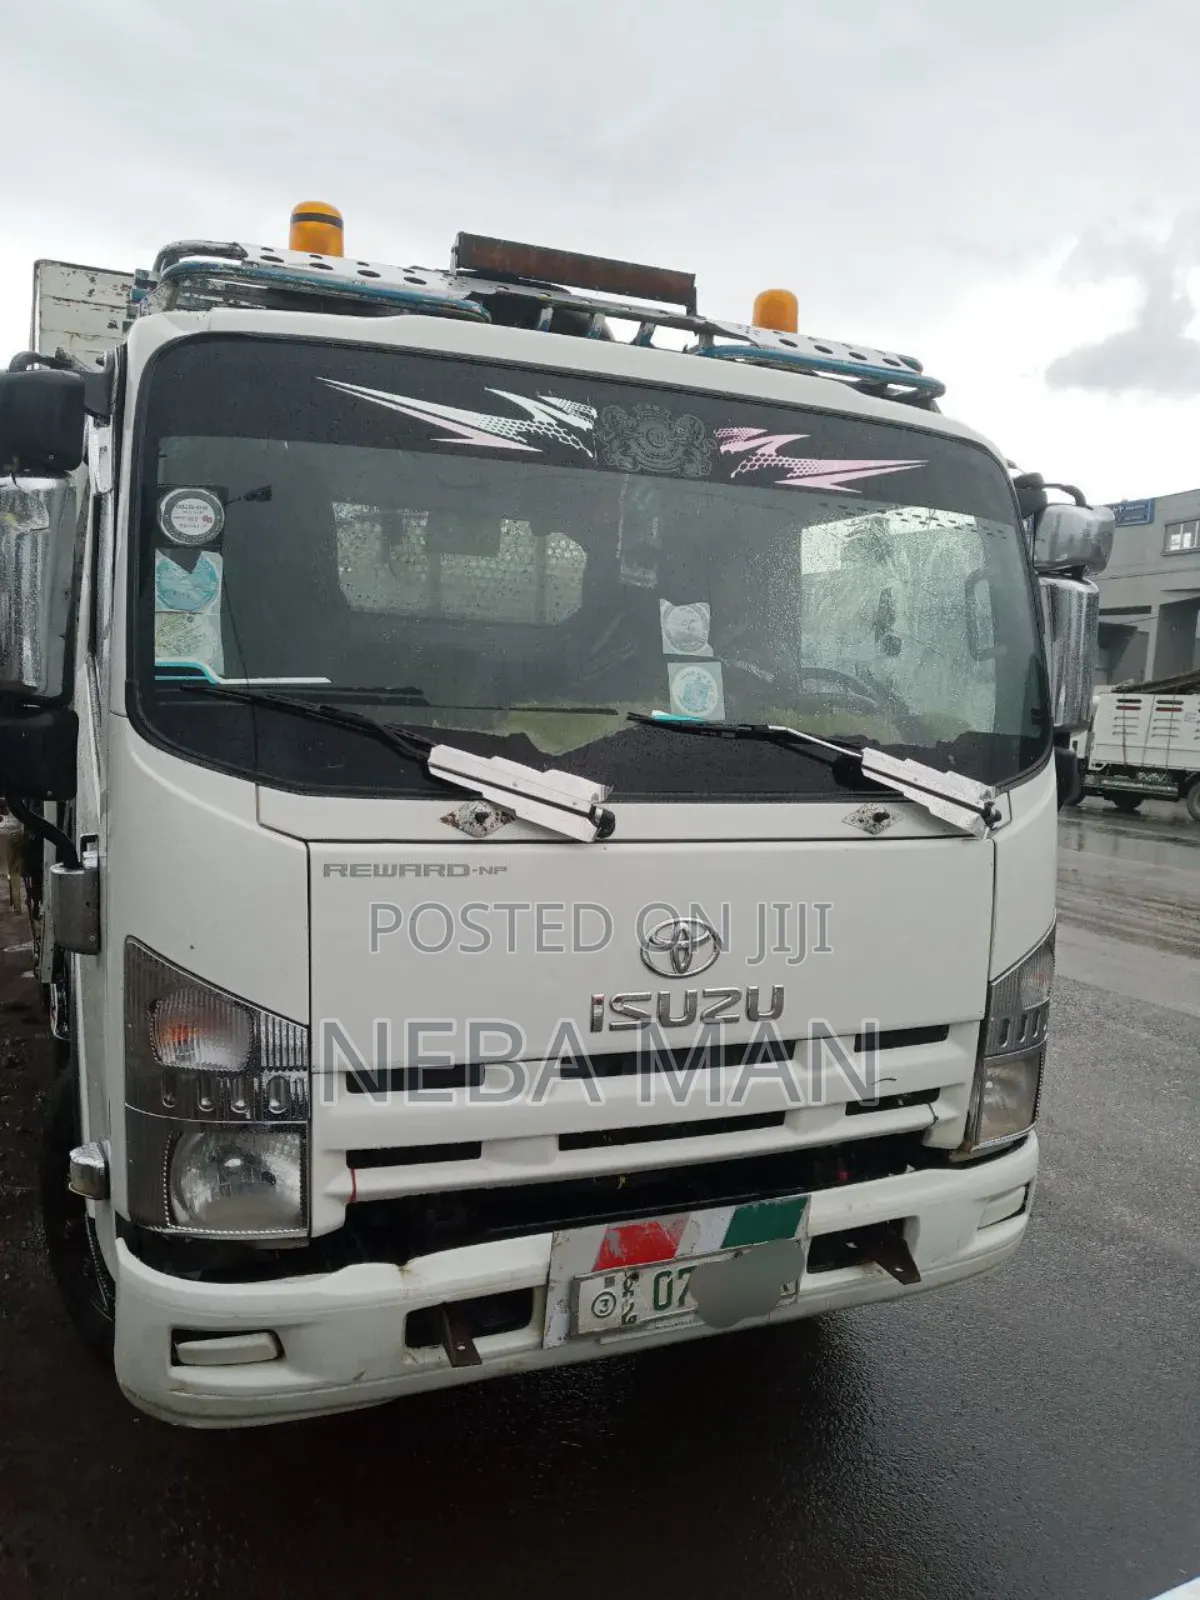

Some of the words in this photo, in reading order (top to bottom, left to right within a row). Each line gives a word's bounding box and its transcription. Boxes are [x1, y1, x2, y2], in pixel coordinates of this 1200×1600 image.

[323, 863, 508, 878] REWARD-NP
[590, 984, 784, 1032] ISUZU
[653, 1265, 697, 1311] 07
